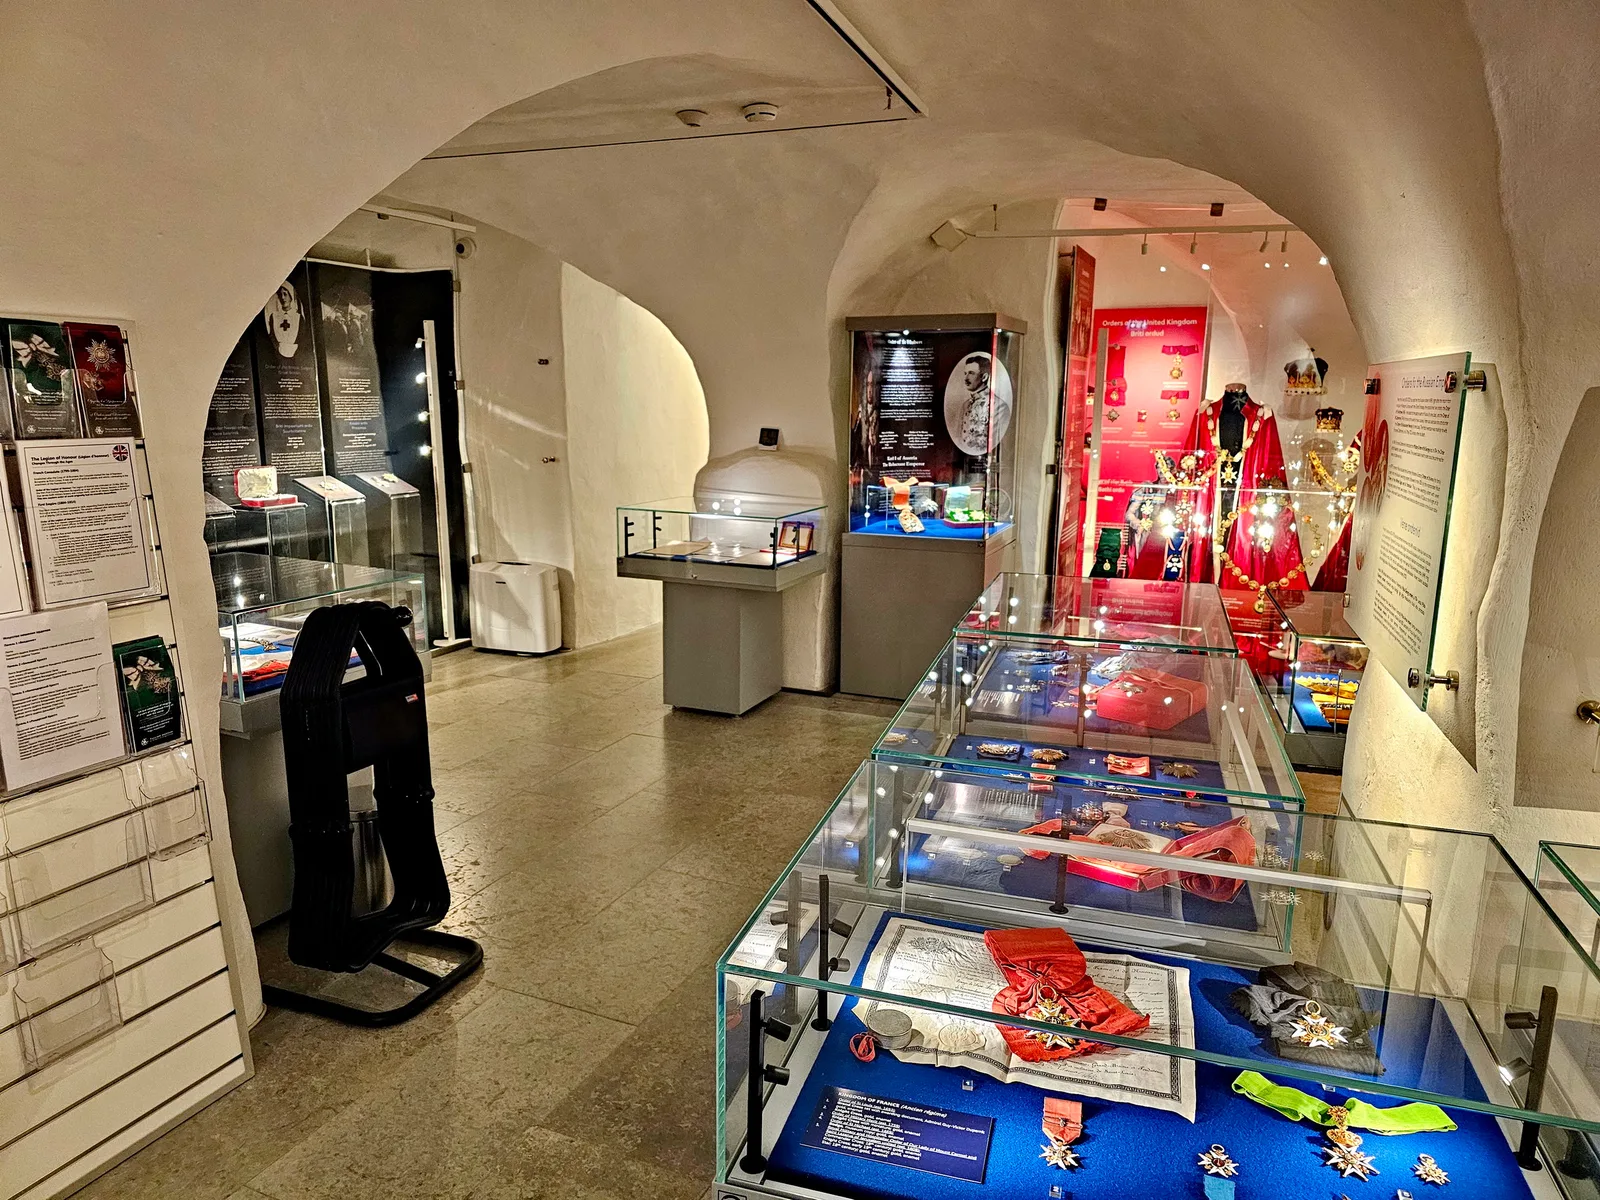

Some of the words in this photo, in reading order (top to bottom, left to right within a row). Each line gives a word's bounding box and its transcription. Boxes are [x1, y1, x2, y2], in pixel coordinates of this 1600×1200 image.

[838, 1091, 867, 1101] KINGDOM
[876, 1099, 899, 1107] FRANCE
[900, 1104, 923, 1112] (Ancien
